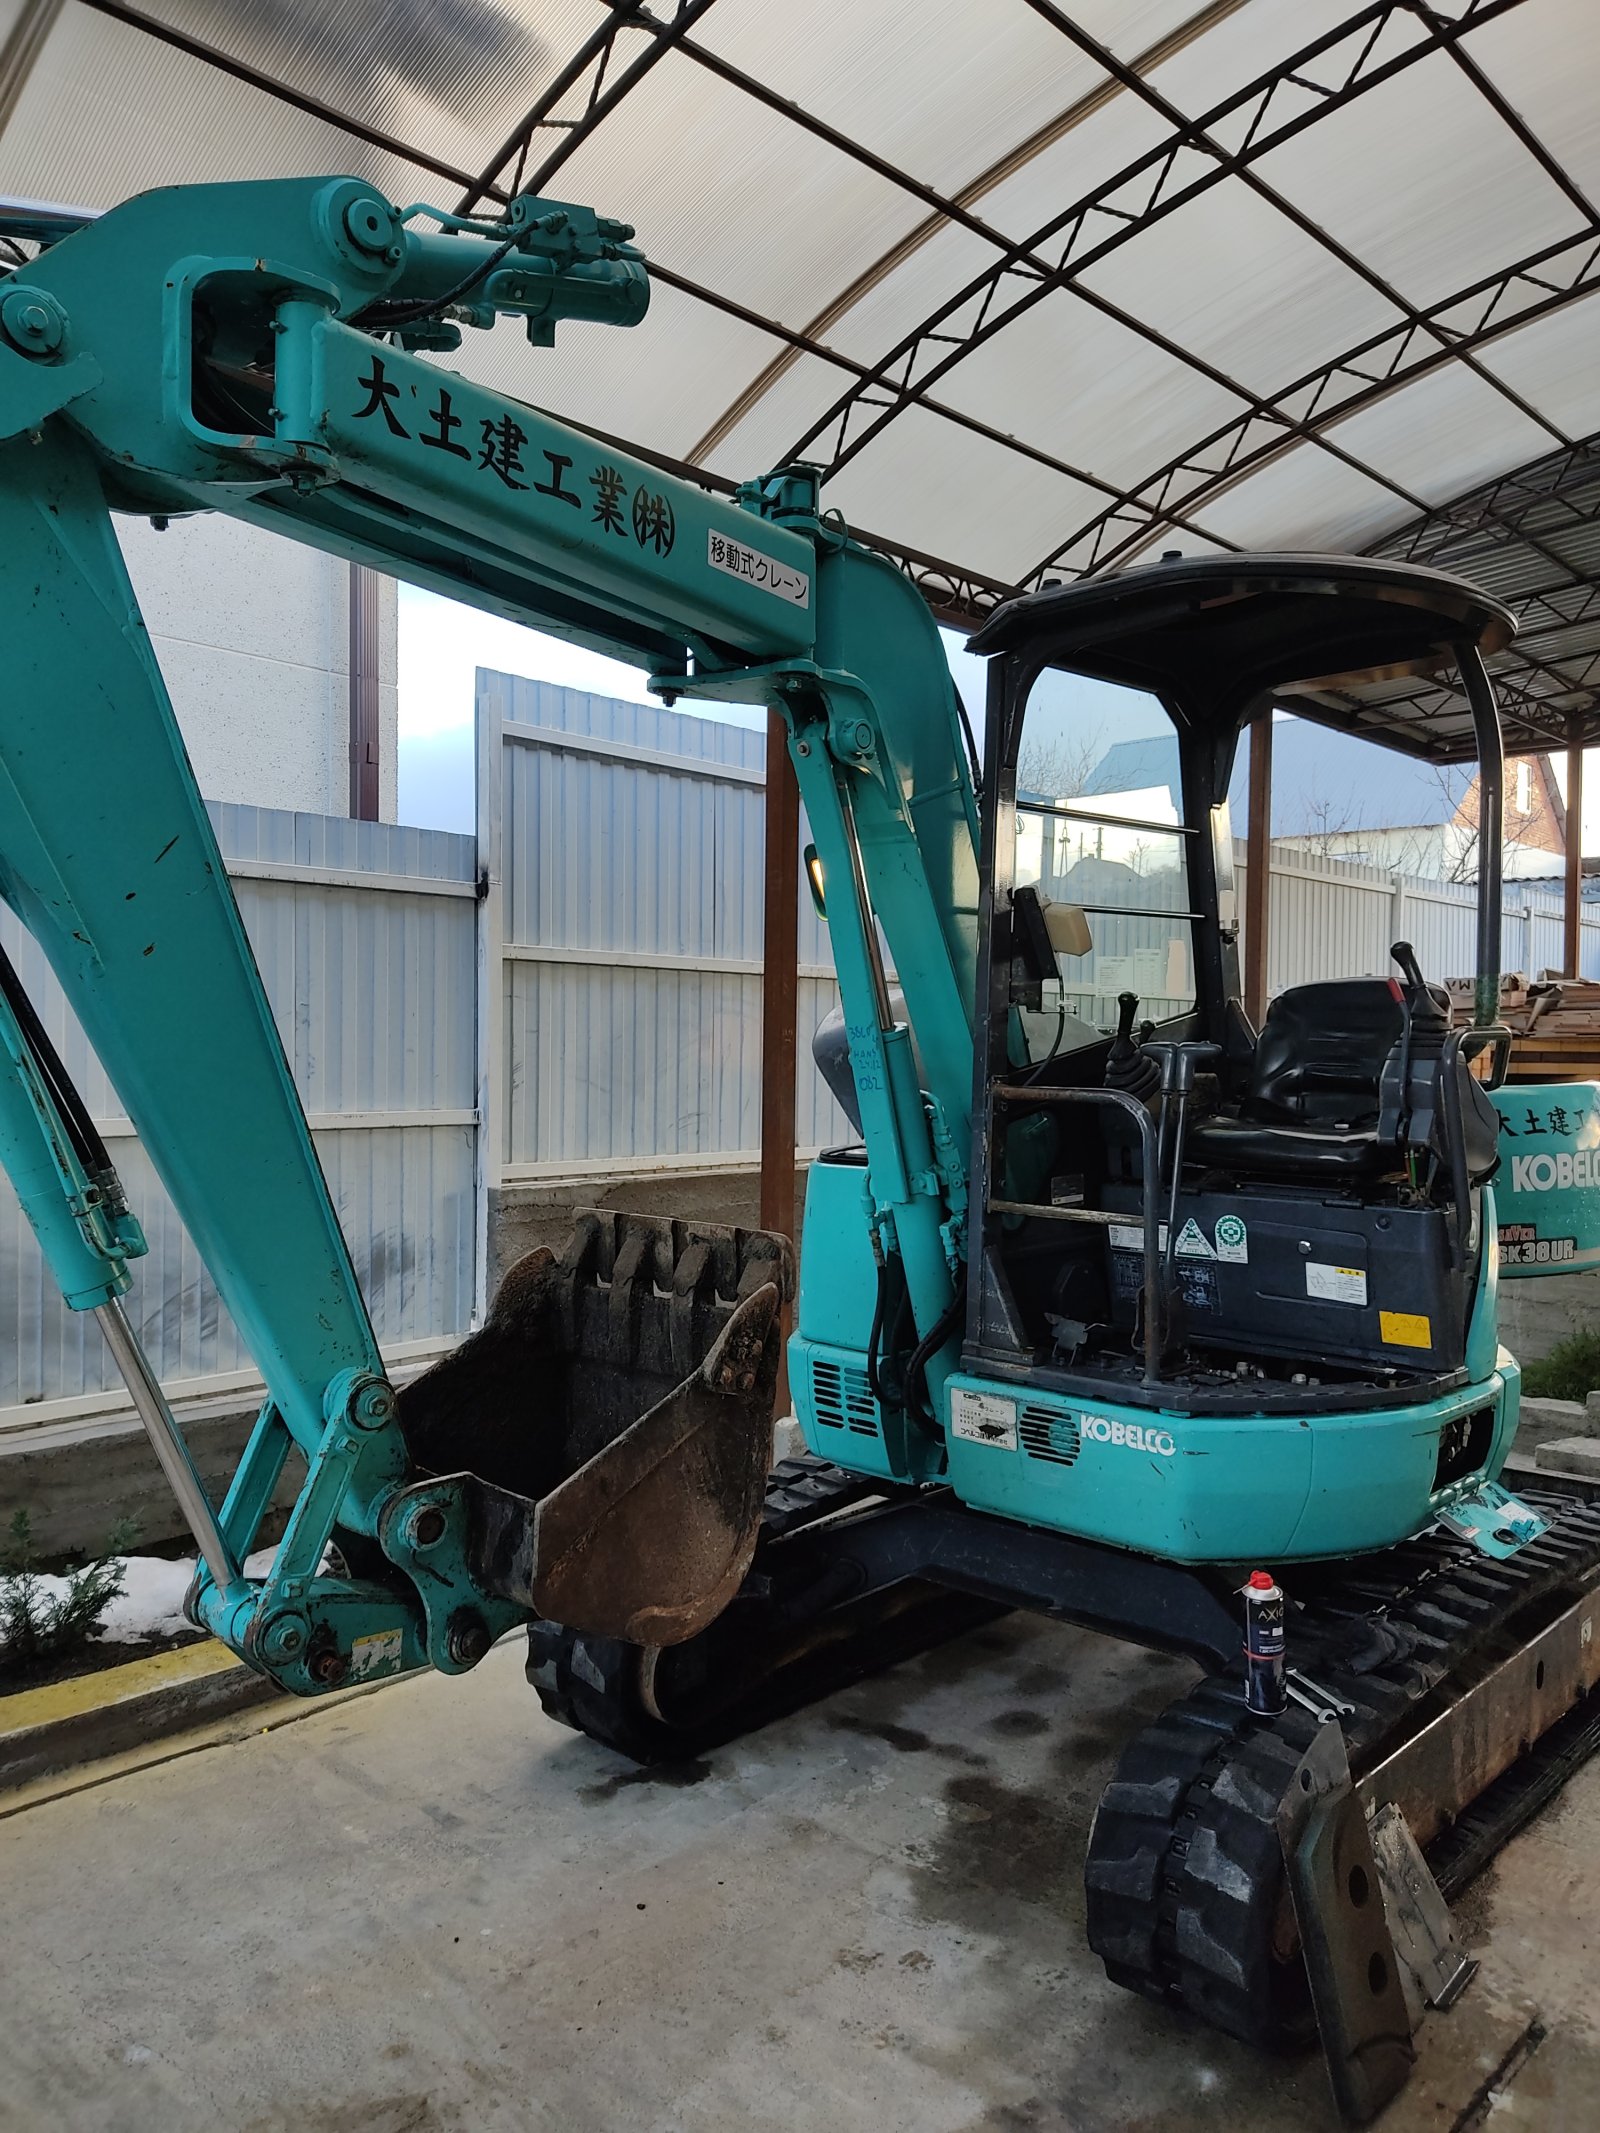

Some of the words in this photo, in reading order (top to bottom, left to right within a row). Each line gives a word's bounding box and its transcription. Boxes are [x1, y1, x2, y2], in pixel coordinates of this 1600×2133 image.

[711, 536, 807, 599] 移動式クレーン
[1499, 1239, 1574, 1263] SK38UR
[1081, 1415, 1176, 1456] KOBELCO
